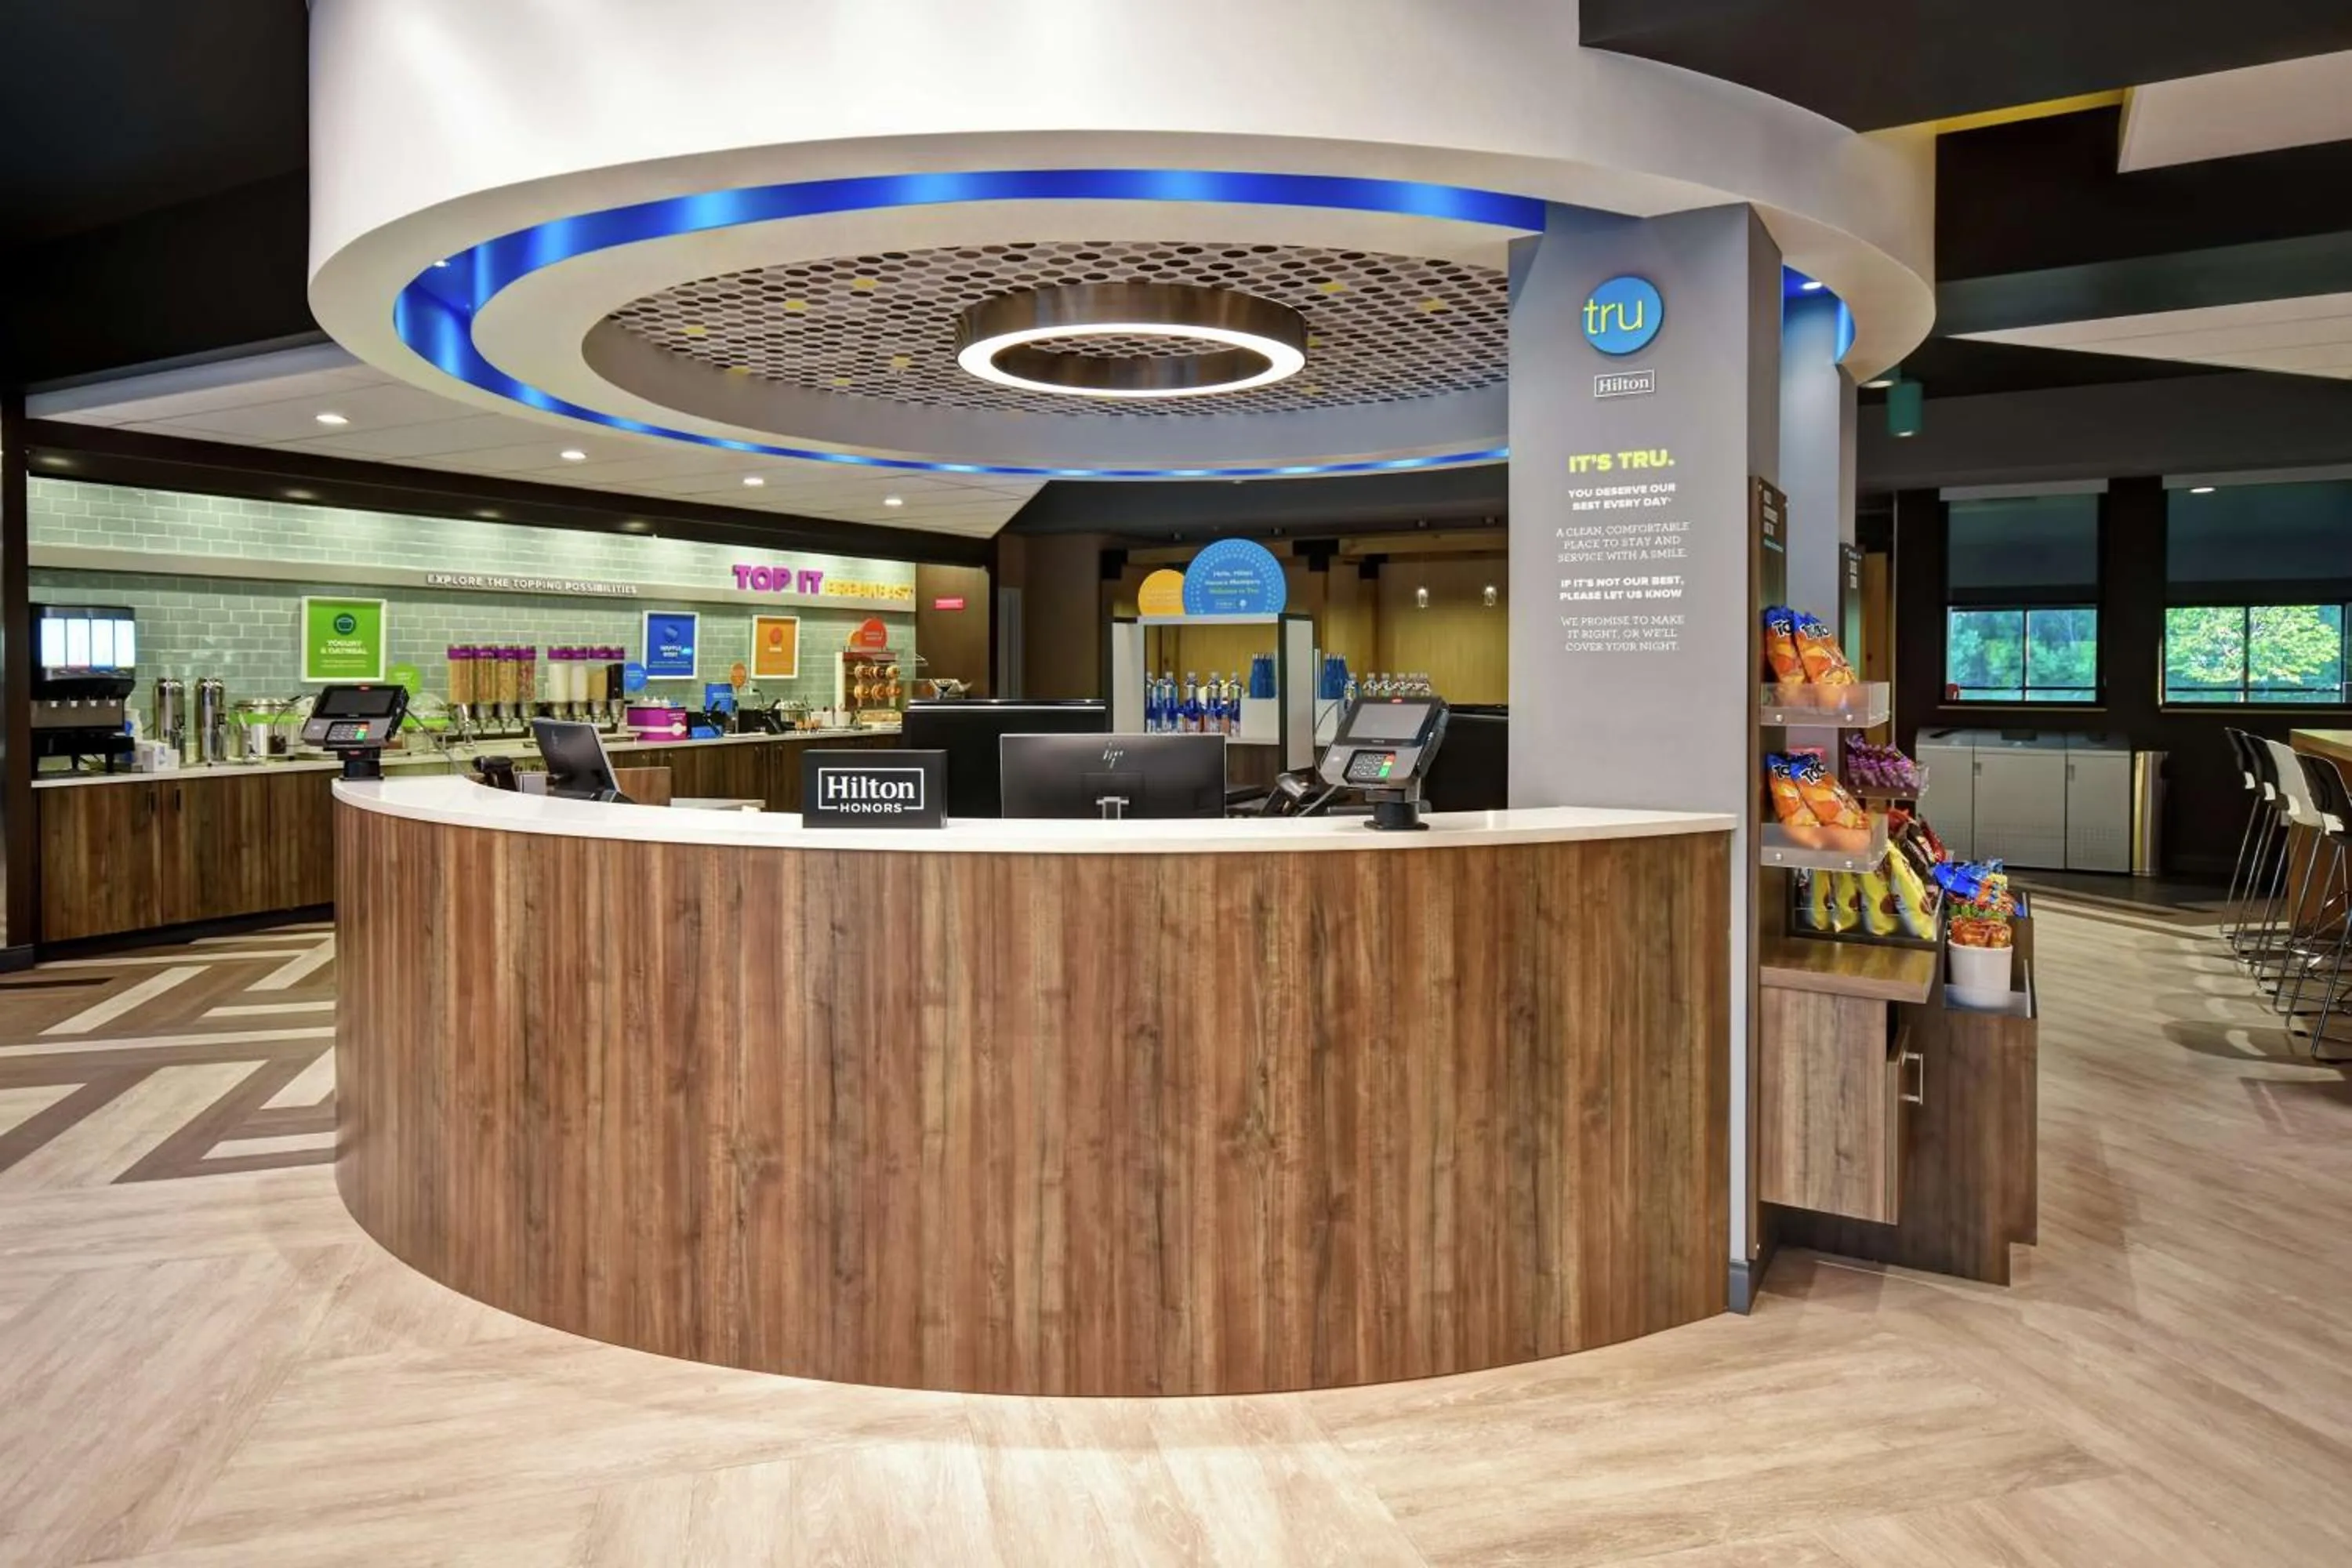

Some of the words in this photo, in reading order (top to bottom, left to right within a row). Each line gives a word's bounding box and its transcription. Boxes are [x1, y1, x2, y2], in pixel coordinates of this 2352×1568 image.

[1583, 298, 1643, 335] tru
[1599, 378, 1649, 392] Hilton
[1569, 454, 1612, 473] IT'S
[1618, 449, 1675, 469] TRU.
[1568, 488, 1592, 499] YOU
[1595, 485, 1648, 496] DESERVE
[1650, 483, 1676, 493] OUR
[1573, 500, 1601, 510] BEST
[1604, 498, 1641, 510] EVERY
[1556, 528, 1564, 538] A
[1566, 526, 1605, 537] CLEAN,
[1606, 521, 1690, 535] COMFORTABLE
[1563, 539, 1600, 550] PLACE
[1602, 539, 1619, 548] TO
[1621, 536, 1652, 546] STAY
[1654, 535, 1682, 546] AND
[1558, 551, 1604, 563] SERVICE
[1606, 550, 1638, 561] WITH
[1639, 550, 1649, 560] A
[427, 574, 482, 586] EXPLORE
[487, 577, 508, 588] THE
[513, 578, 562, 591] TOPPING
[565, 580, 637, 594] POSSIBILITIES
[732, 564, 792, 592] TOP
[797, 570, 823, 595] IT
[1561, 579, 1572, 588] IF
[1573, 579, 1594, 588] IT'S
[1596, 578, 1621, 587] NOT
[1623, 577, 1649, 586] OUR
[1559, 591, 1602, 601] PLEASE
[1604, 590, 1625, 600] LET
[1627, 590, 1642, 599] US
[1646, 589, 1682, 598] KNOW
[1560, 616, 1578, 627] WE
[1581, 615, 1630, 626] PROMISE
[1632, 615, 1649, 625] TO
[1650, 614, 1685, 625] MAKE
[1568, 630, 1579, 639] IT
[1581, 629, 1621, 640] RIGHT,
[1622, 628, 1639, 638] OR
[1642, 627, 1678, 637] WE'LL
[1565, 642, 1604, 652] COVER
[1606, 641, 1638, 652] YOUR
[826, 775, 916, 799] Hilton
[840, 803, 902, 813] HONORS
